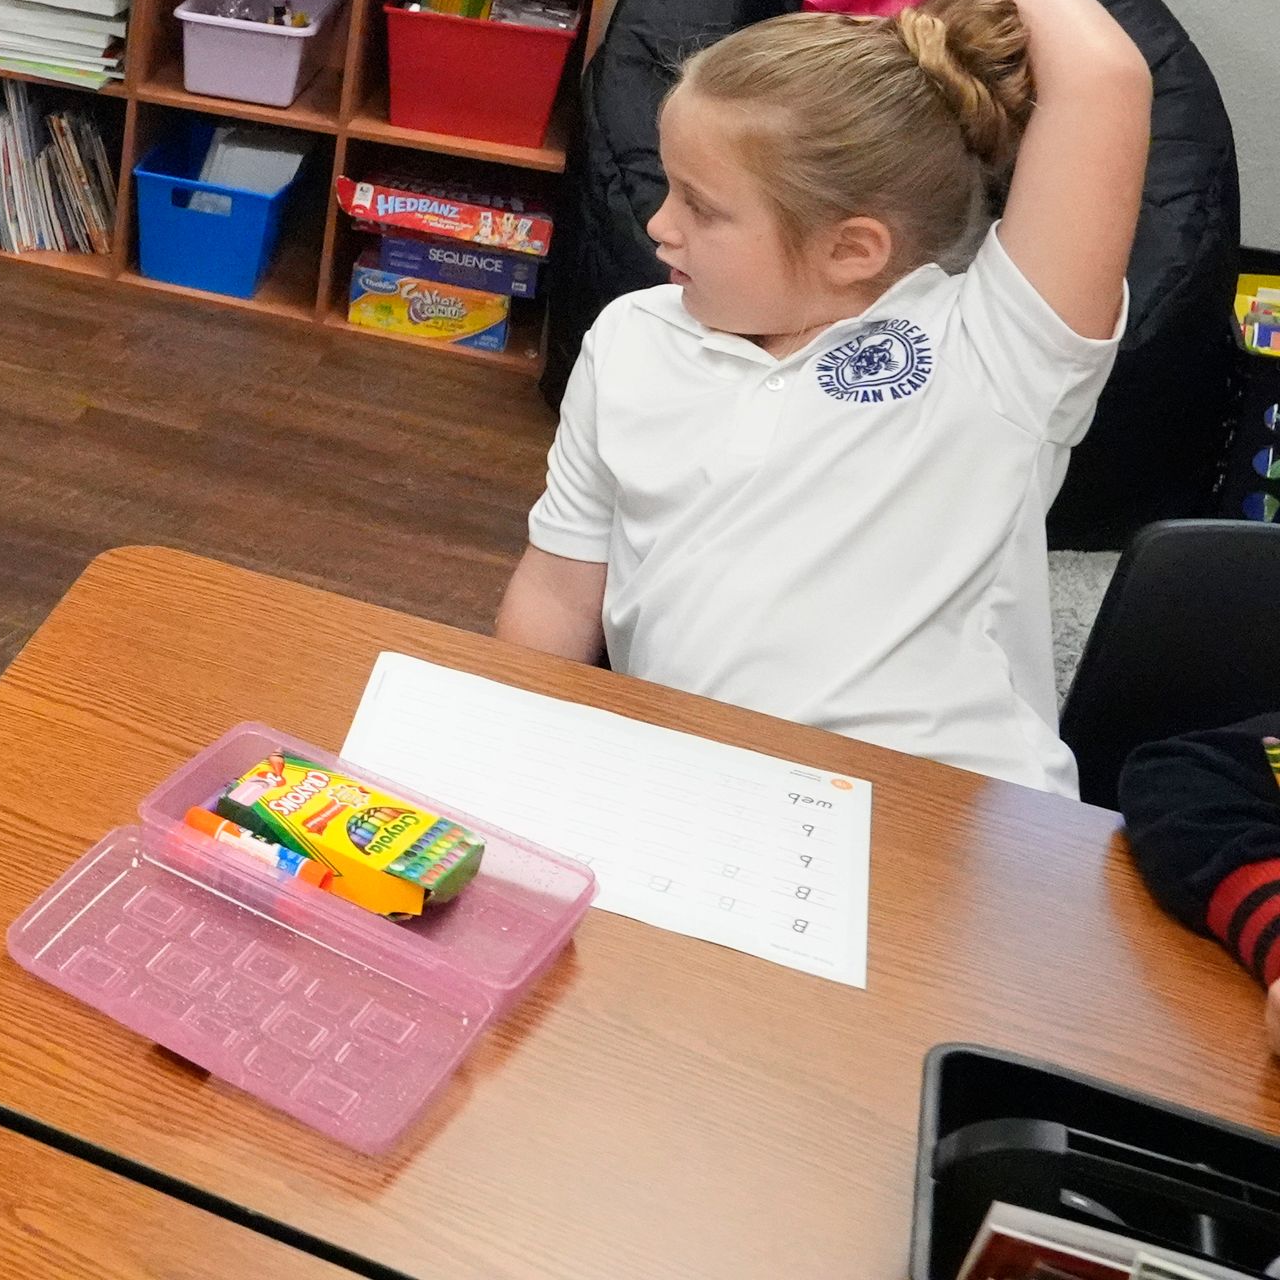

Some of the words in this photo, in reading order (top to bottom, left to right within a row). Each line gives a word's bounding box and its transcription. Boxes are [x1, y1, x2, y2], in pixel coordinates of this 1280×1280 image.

[376, 193, 462, 219] HEDBANZ
[428, 247, 504, 273] SEQUENCE
[817, 373, 885, 404] CHRISTIAN
[890, 346, 933, 401] ACADEMY
[269, 771, 330, 816] CRAYONS
[787, 791, 834, 810] web
[368, 814, 421, 855] Crayola
[795, 885, 812, 901] B
[792, 918, 809, 934] B
